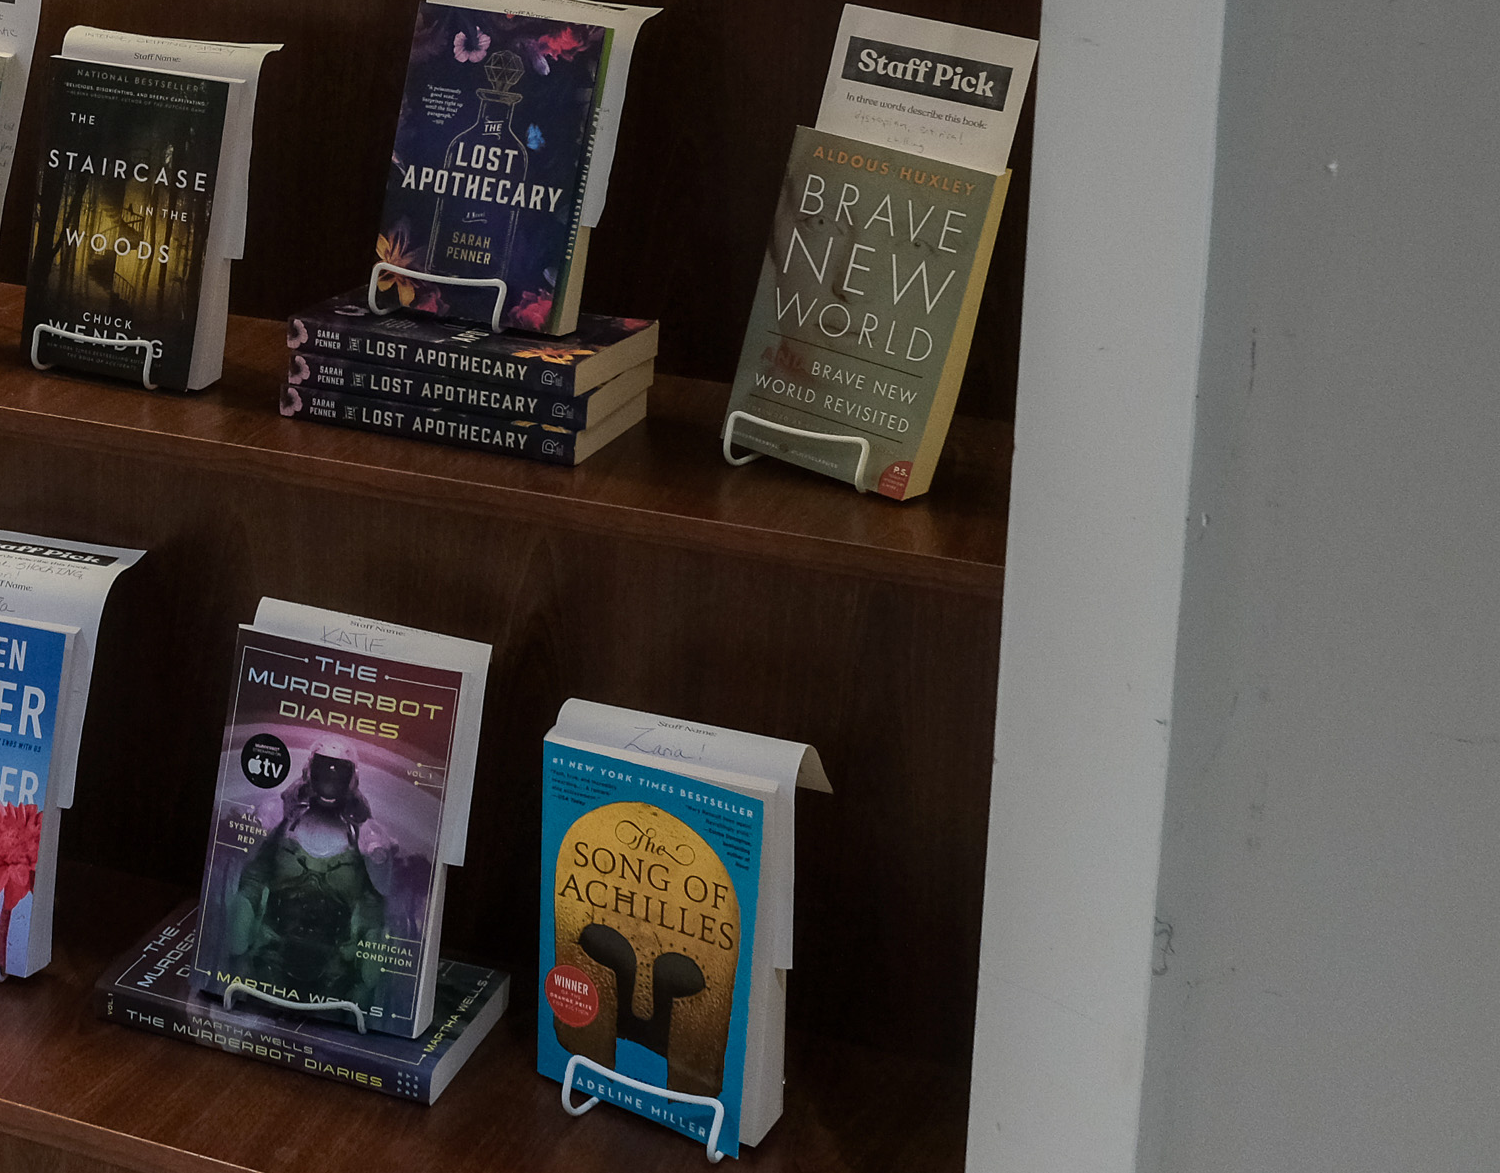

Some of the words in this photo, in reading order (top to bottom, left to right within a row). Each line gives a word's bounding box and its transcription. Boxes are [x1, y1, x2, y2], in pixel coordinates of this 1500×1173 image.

[76, 68, 130, 84] NATIONAL
[856, 48, 933, 84] Staff
[931, 63, 995, 98] Pick
[70, 112, 97, 126] THE
[47, 148, 208, 193] STAIRCASE
[455, 141, 519, 175] LOST
[813, 145, 890, 175] ALDOUS
[899, 167, 977, 196] HUXLEY
[400, 164, 564, 214] APOTHECARY
[139, 205, 155, 217] IN
[162, 208, 189, 223] THE
[799, 173, 967, 254] BRAVE
[65, 227, 171, 264] WOODS
[446, 246, 492, 266] PENNER
[451, 231, 492, 250] SARAH
[782, 227, 957, 315] NEW
[82, 311, 133, 330] CHUCK
[775, 286, 933, 362] WORLD
[365, 339, 408, 361] LOST
[414, 347, 529, 382] APOTHECARY
[369, 374, 414, 396] LOST
[420, 382, 539, 415] APOTHECARY
[754, 371, 816, 404] WORLD
[823, 394, 910, 434] REVISITED
[810, 361, 867, 391] BRAVE
[872, 379, 918, 406] NEW
[361, 407, 405, 429] LOST
[411, 416, 529, 451] APOTHECARY
[319, 625, 387, 653] KATIE
[314, 655, 378, 684] THE
[247, 667, 444, 721] MURDERBOT
[278, 699, 400, 740] DIARIES
[551, 756, 565, 766] #1
[568, 759, 595, 773] NEW
[600, 767, 634, 784] YORK
[638, 777, 675, 795] TIMES
[679, 787, 755, 820] BESTSELLER
[228, 821, 268, 838] SYSTEMS
[240, 812, 258, 824] ALL
[573, 841, 672, 893] SONG
[683, 873, 729, 913] OF
[557, 872, 735, 953] ACHILLES
[355, 950, 413, 968] CONDITION
[357, 939, 413, 958] ARTIFICIAL
[216, 969, 300, 1002] MARTHA
[553, 972, 590, 997] WINNER
[125, 1008, 165, 1029] THE
[172, 1021, 296, 1064] MURDERBOT
[304, 1057, 384, 1089] DIARIES
[191, 1015, 253, 1040] MARTHA
[259, 1034, 314, 1056] WELLS
[650, 1101, 707, 1140] MILLER
